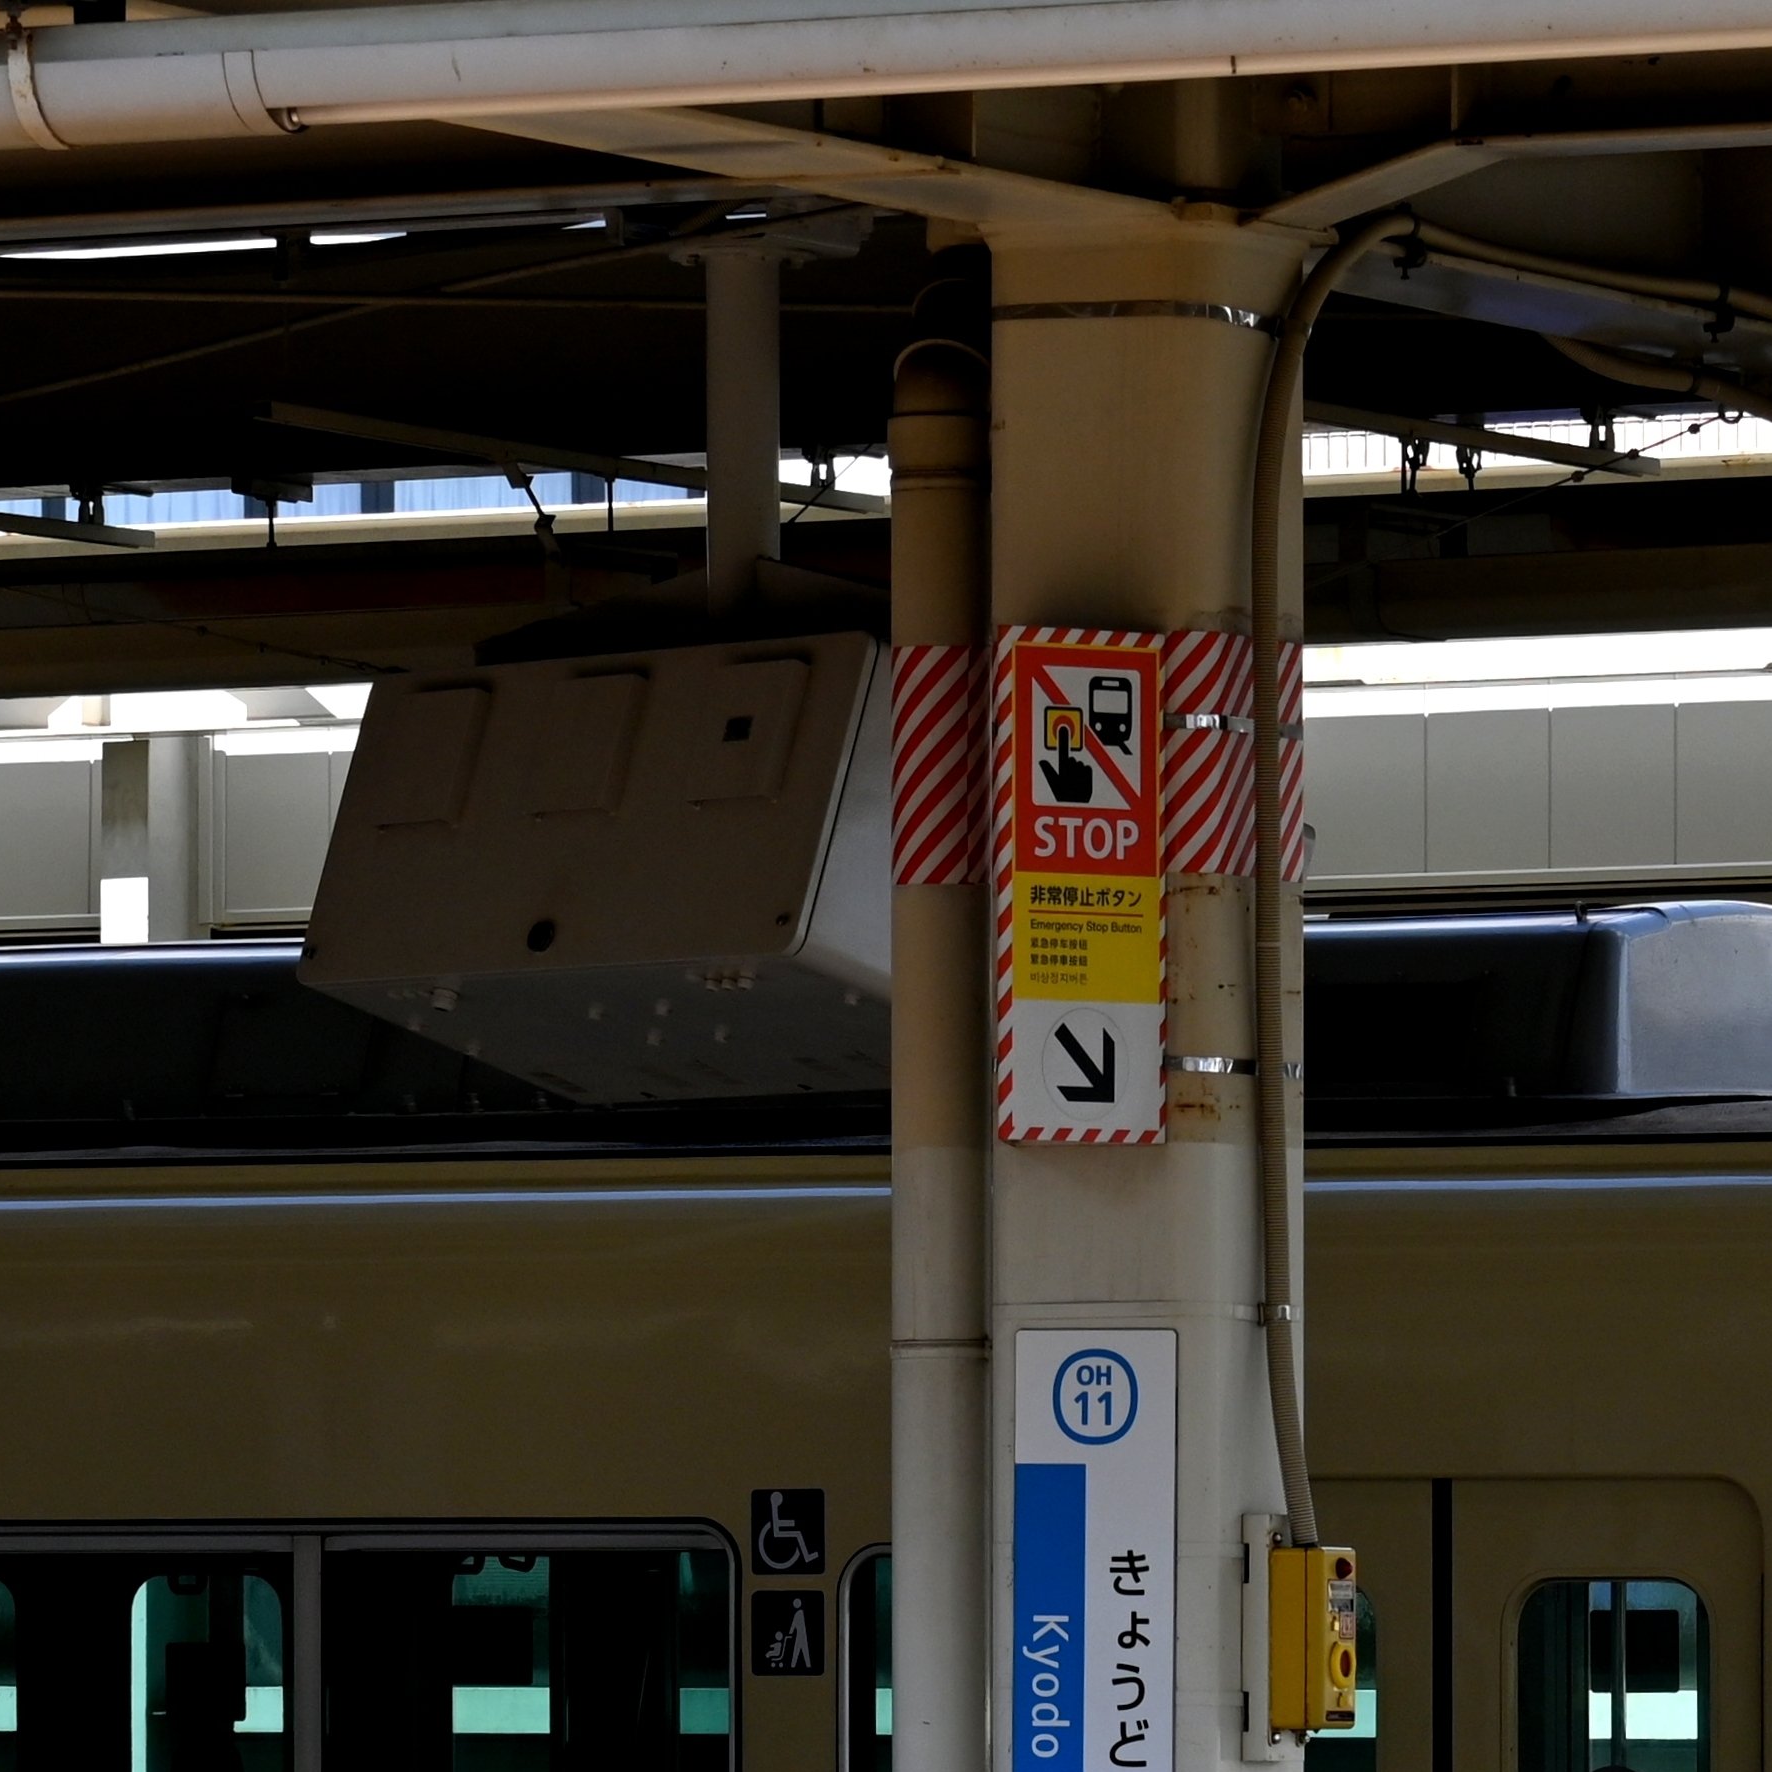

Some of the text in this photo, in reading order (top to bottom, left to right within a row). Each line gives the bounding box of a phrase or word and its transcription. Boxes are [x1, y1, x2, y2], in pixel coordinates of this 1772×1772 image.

[1033, 815, 1139, 860] STOP
[1030, 884, 1142, 908] 非常停止ボタン
[1030, 919, 1142, 934] Emergency Stop Button
[1075, 1364, 1112, 1386] OH
[1073, 1391, 1114, 1426] 11
[1022, 1614, 1071, 1758] Kyodo
